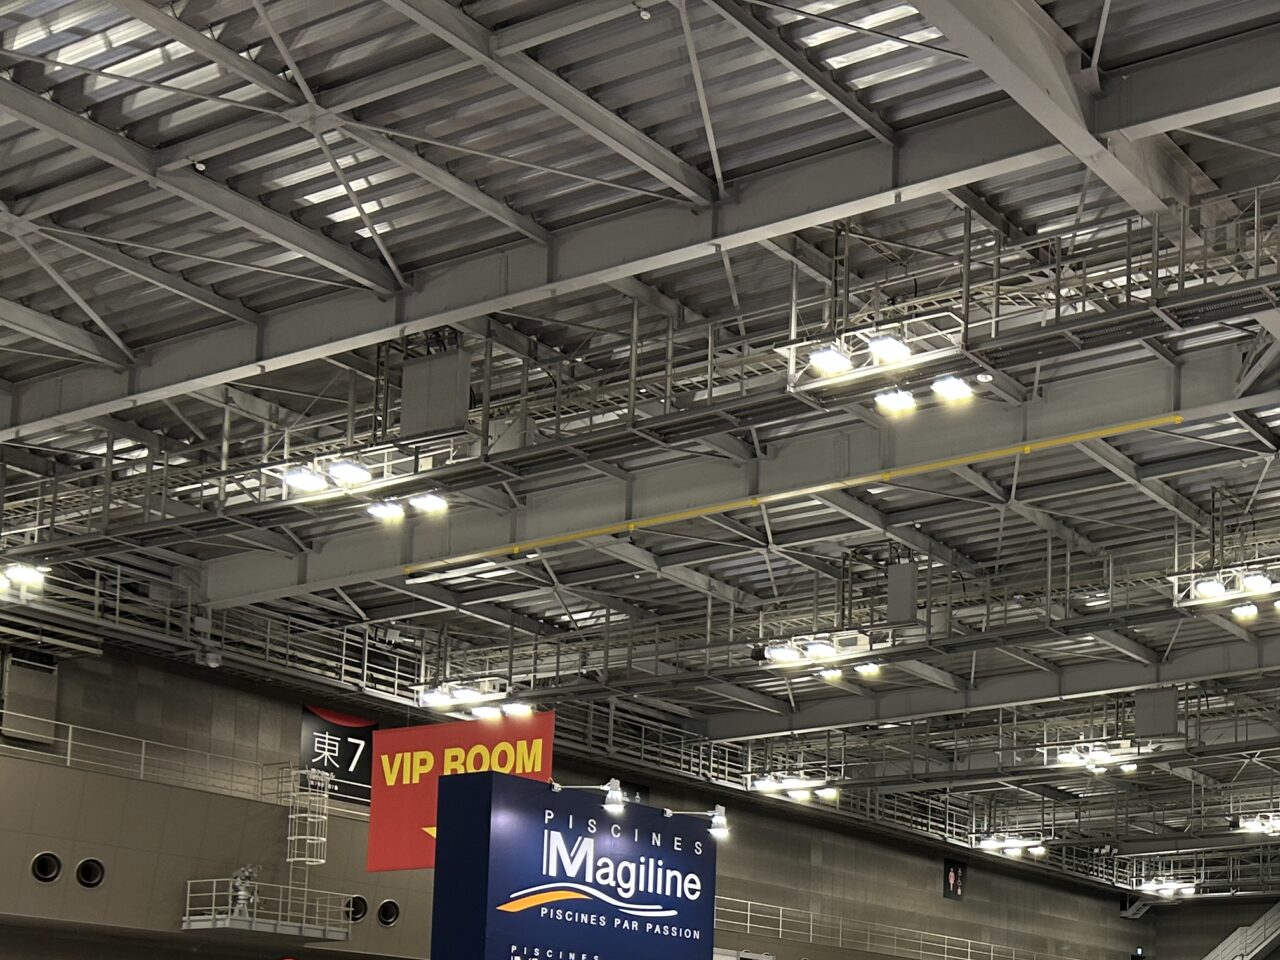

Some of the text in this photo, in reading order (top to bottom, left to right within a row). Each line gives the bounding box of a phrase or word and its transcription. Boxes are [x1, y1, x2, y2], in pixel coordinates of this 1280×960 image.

[311, 731, 366, 772] 東7
[380, 738, 543, 786] VIP ROOM
[544, 809, 703, 855] PISCINES
[541, 907, 700, 940] PISCINES PAR PASSION
